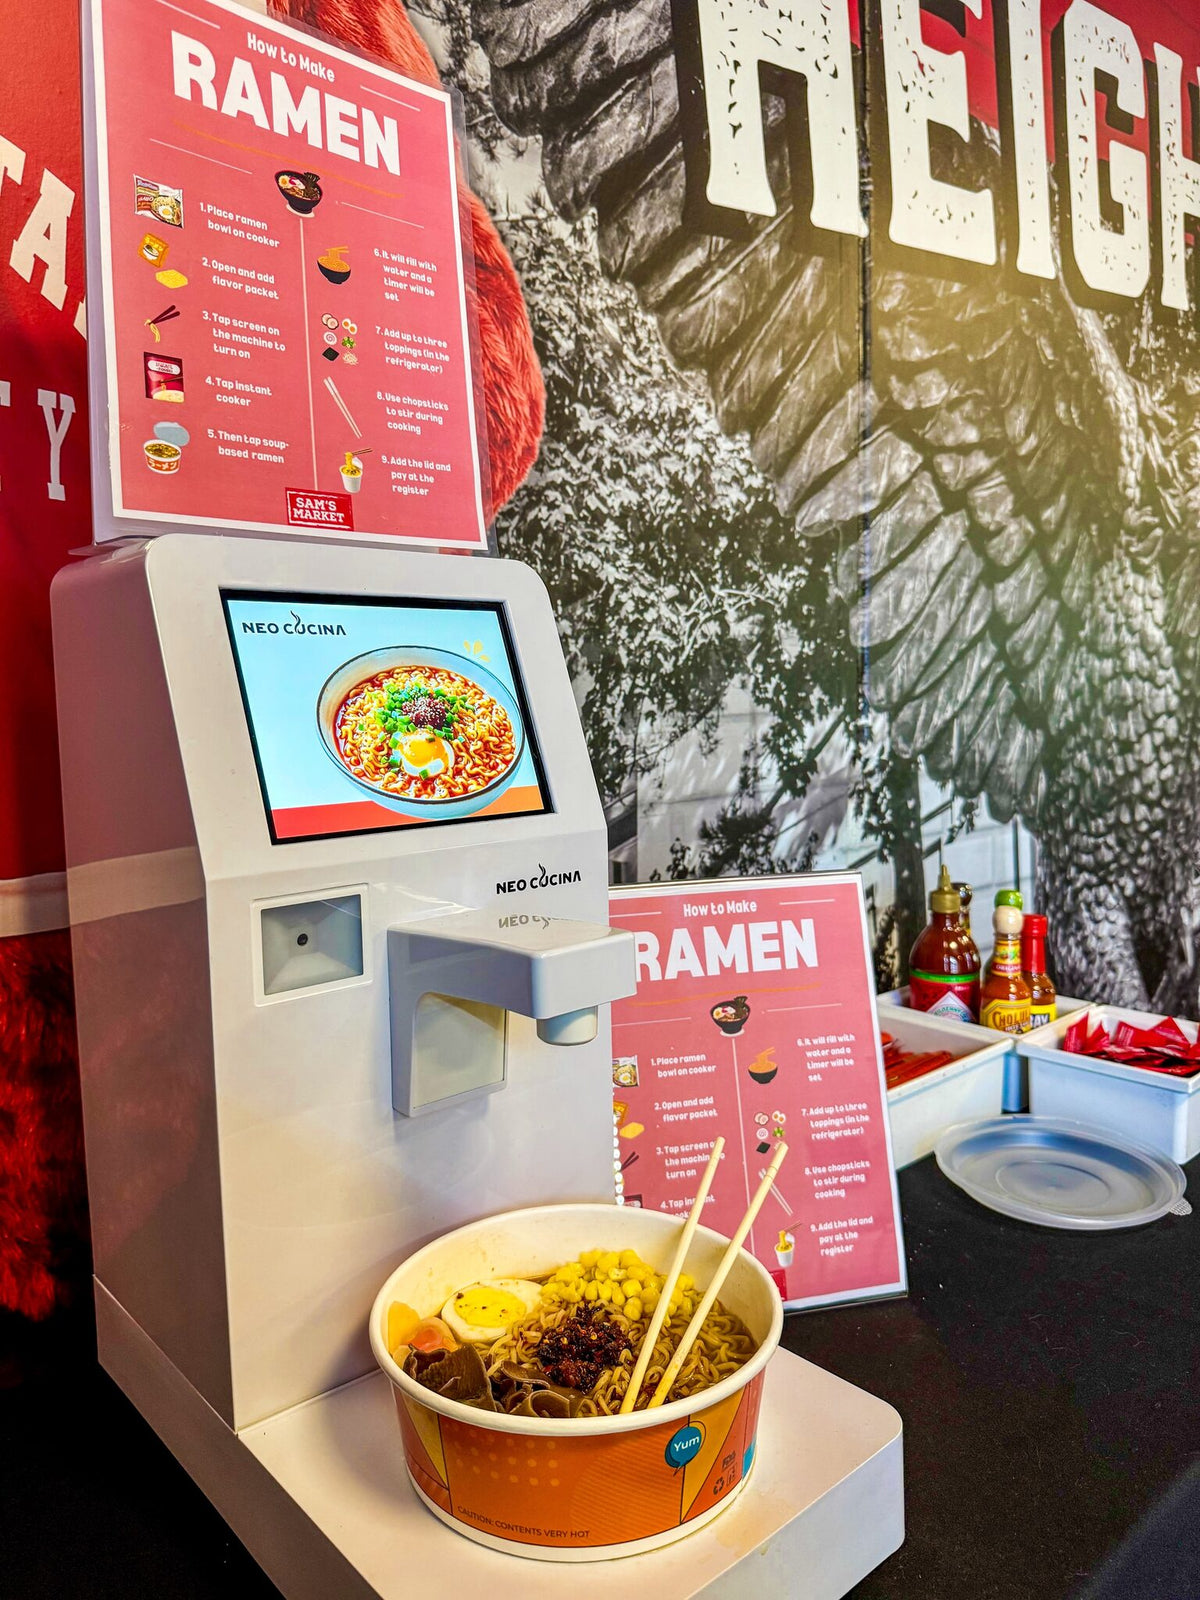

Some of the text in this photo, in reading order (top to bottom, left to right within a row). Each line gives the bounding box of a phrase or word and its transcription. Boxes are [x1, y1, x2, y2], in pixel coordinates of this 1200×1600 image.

[247, 32, 335, 83] How to Make
[170, 30, 400, 176] RAMEN
[207, 204, 234, 220] Place
[236, 214, 268, 230] ramen
[208, 219, 280, 248] bowl on cooker
[382, 250, 389, 260] It
[391, 253, 405, 264] will
[406, 256, 417, 266] fill
[418, 260, 437, 272] with
[212, 259, 236, 274] Open
[238, 267, 256, 279] and
[257, 272, 275, 284] add
[383, 264, 409, 277] water
[410, 270, 426, 282] and
[212, 275, 279, 300] flavor packet
[384, 277, 435, 296] timer will be
[384, 292, 399, 301] set
[212, 313, 230, 326] Tap
[232, 319, 266, 333] screen
[268, 327, 280, 336] on
[212, 328, 286, 351] the machine to
[384, 328, 400, 338] Add
[402, 333, 412, 342] up
[413, 334, 422, 343] to
[424, 335, 447, 348] three
[213, 343, 250, 359] turn on
[384, 342, 450, 361] toppings (in the
[385, 356, 443, 374] refrigerator)
[215, 377, 234, 390] Tap
[235, 381, 272, 396] instant
[216, 394, 251, 406] cooker
[385, 393, 400, 402] Use
[402, 396, 448, 411] chopsticks
[386, 407, 443, 425] to stir during
[387, 421, 421, 435] cooking
[218, 431, 246, 442] Then
[245, 434, 261, 446] tap
[262, 438, 290, 449] soup-
[218, 446, 284, 463] based ramen
[390, 456, 407, 466] Add
[408, 459, 422, 467] the
[424, 461, 434, 469] lid
[436, 463, 451, 472] and
[391, 471, 434, 483] pay at the
[392, 484, 429, 495] register
[296, 497, 337, 511] SAM'S
[293, 508, 345, 523] MARKET
[242, 622, 279, 634] NEO
[496, 879, 526, 894] NEO
[683, 899, 757, 917] How to Make
[635, 918, 819, 982] RAMEN
[805, 1038, 811, 1046] It
[837, 1034, 855, 1042] with
[657, 1056, 678, 1065] Place
[679, 1054, 706, 1063] ramen
[806, 1049, 829, 1057] water
[831, 1047, 845, 1055] and
[657, 1064, 716, 1078] bowl on cooker
[807, 1058, 854, 1070] timer will be
[808, 1074, 822, 1082] set
[662, 1099, 682, 1111] Open
[683, 1098, 698, 1106] and
[699, 1096, 714, 1104] add
[810, 1106, 824, 1116] Add
[825, 1106, 834, 1114] up
[835, 1104, 844, 1112] to
[845, 1102, 867, 1112] three
[663, 1109, 718, 1122] flavor packet
[810, 1114, 870, 1128] toppings (in the
[812, 1127, 864, 1140] refrigerator)
[664, 1145, 679, 1154] Tap
[680, 1142, 708, 1151] screen
[710, 1140, 715, 1148] o
[665, 1158, 679, 1166] the
[680, 1154, 710, 1164] machin
[812, 1166, 826, 1174] Use
[828, 1160, 870, 1173] chopsticks
[666, 1171, 685, 1179] turn
[813, 1173, 866, 1187] to stir during
[815, 1189, 846, 1199] cooking
[669, 1199, 684, 1208] Tap
[818, 1222, 832, 1231] Add
[834, 1220, 847, 1229] the
[849, 1219, 857, 1227] lid
[858, 1216, 873, 1225] and
[819, 1231, 858, 1245] pay at the
[821, 1245, 854, 1256] register
[674, 1436, 700, 1452] Yum
[457, 1506, 590, 1538] CAUTION: CONTENTS VERY HOT
